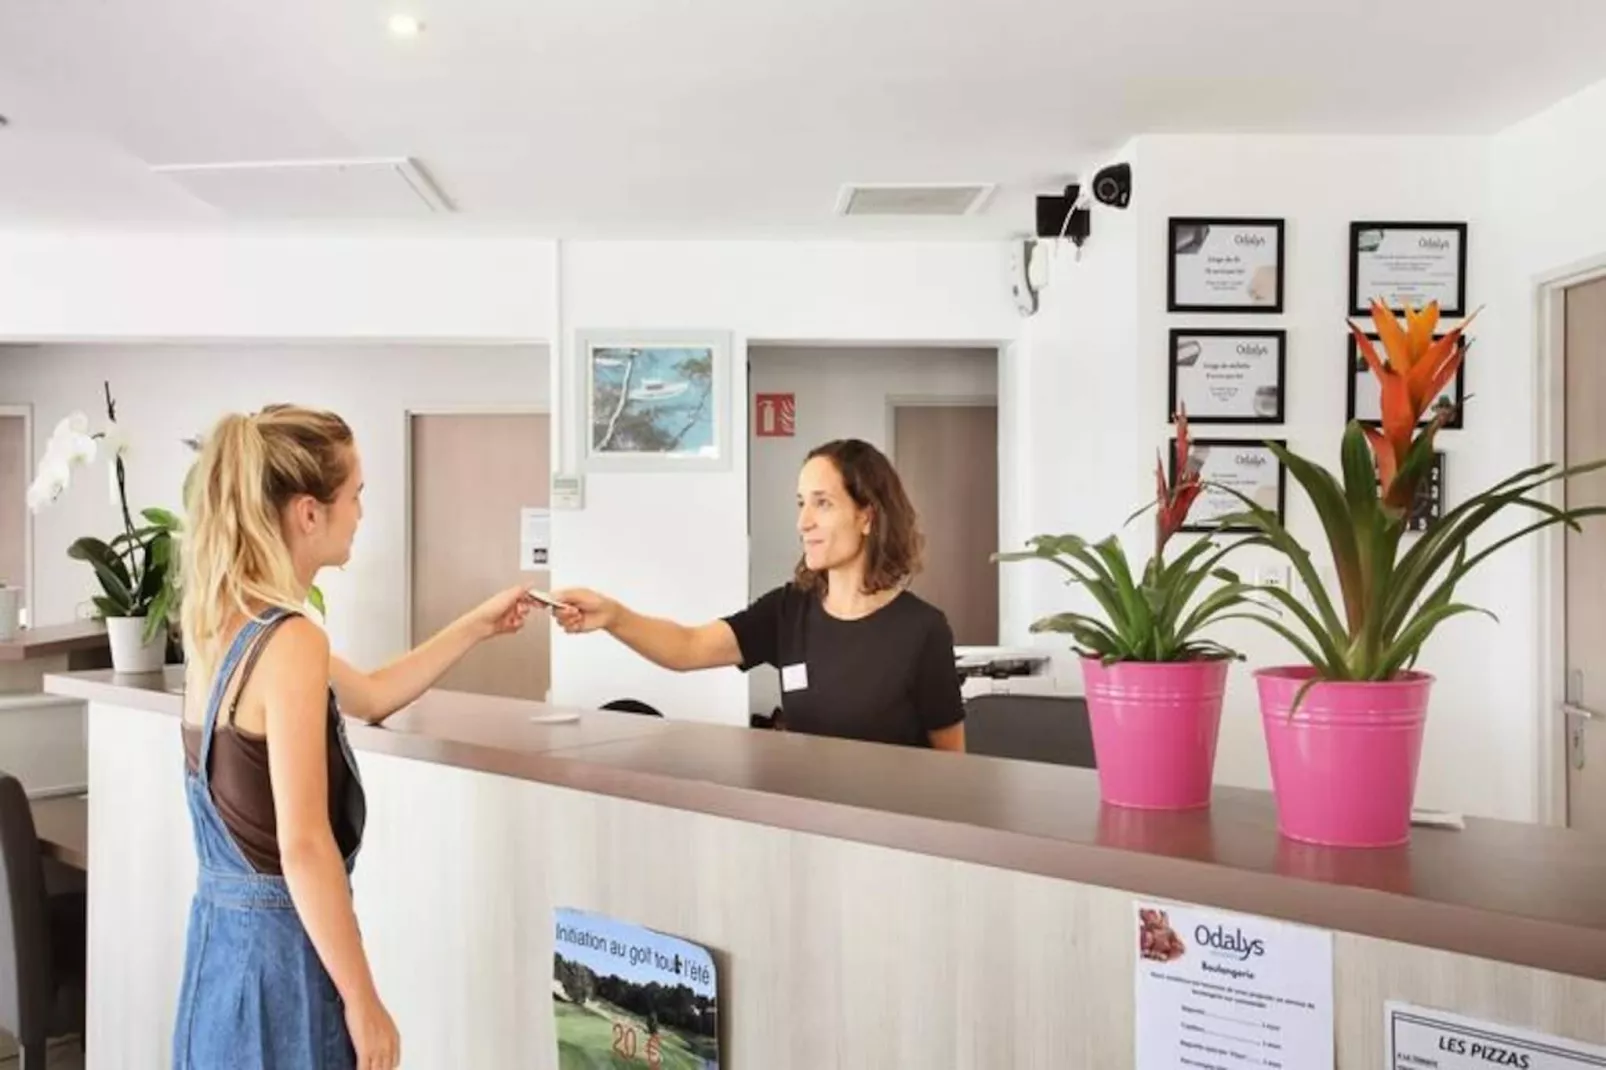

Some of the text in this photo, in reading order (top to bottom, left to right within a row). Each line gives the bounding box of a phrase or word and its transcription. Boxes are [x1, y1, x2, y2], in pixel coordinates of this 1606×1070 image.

[556, 923, 607, 952] Initiation
[610, 941, 626, 957] au
[629, 946, 652, 966] golf
[684, 959, 710, 984] l'été
[1194, 924, 1265, 961] Odalys
[612, 1023, 637, 1060] 20
[1439, 1035, 1531, 1070] LES PIZZAS
